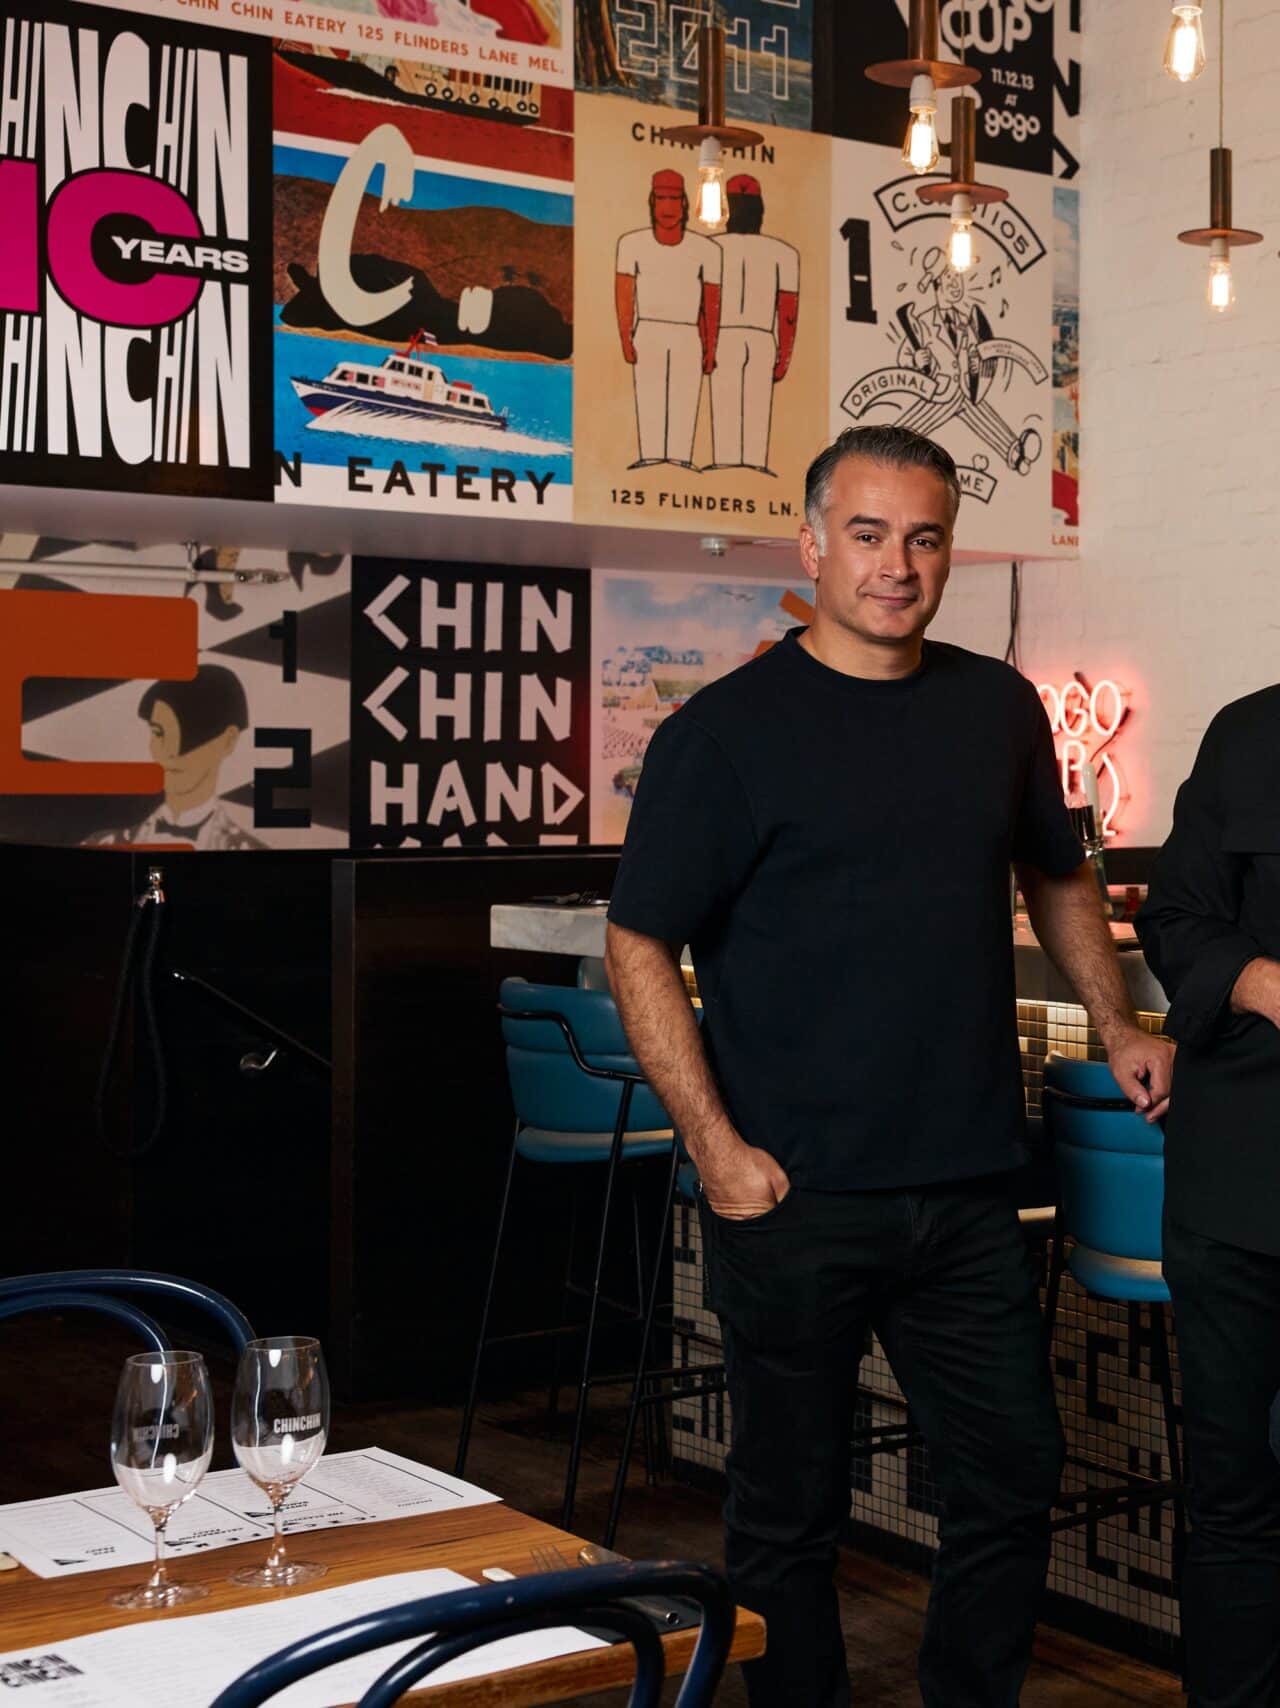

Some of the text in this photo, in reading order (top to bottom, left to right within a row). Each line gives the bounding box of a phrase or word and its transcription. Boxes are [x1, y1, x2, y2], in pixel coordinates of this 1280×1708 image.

[231, 2, 273, 20] CHIN
[284, 11, 347, 33] EATERY
[357, 25, 384, 41] 125
[394, 31, 469, 56] FLINDERS
[479, 47, 518, 65] LANE
[528, 56, 565, 74] MEL.
[991, 67, 1034, 91] 11.12.13
[985, 107, 1041, 142] gogo
[112, 235, 249, 273] YEARS
[852, 374, 928, 407] ORIGINAL
[348, 456, 555, 505] EATERY
[960, 475, 984, 492] ME
[611, 489, 798, 516] 125 FLINDERS LN.
[363, 574, 573, 653] CHIN
[362, 666, 572, 742] CHIN
[1037, 679, 1122, 737] OGO
[370, 760, 585, 827] HAND
[273, 1413, 321, 1434] CHINCHIN
